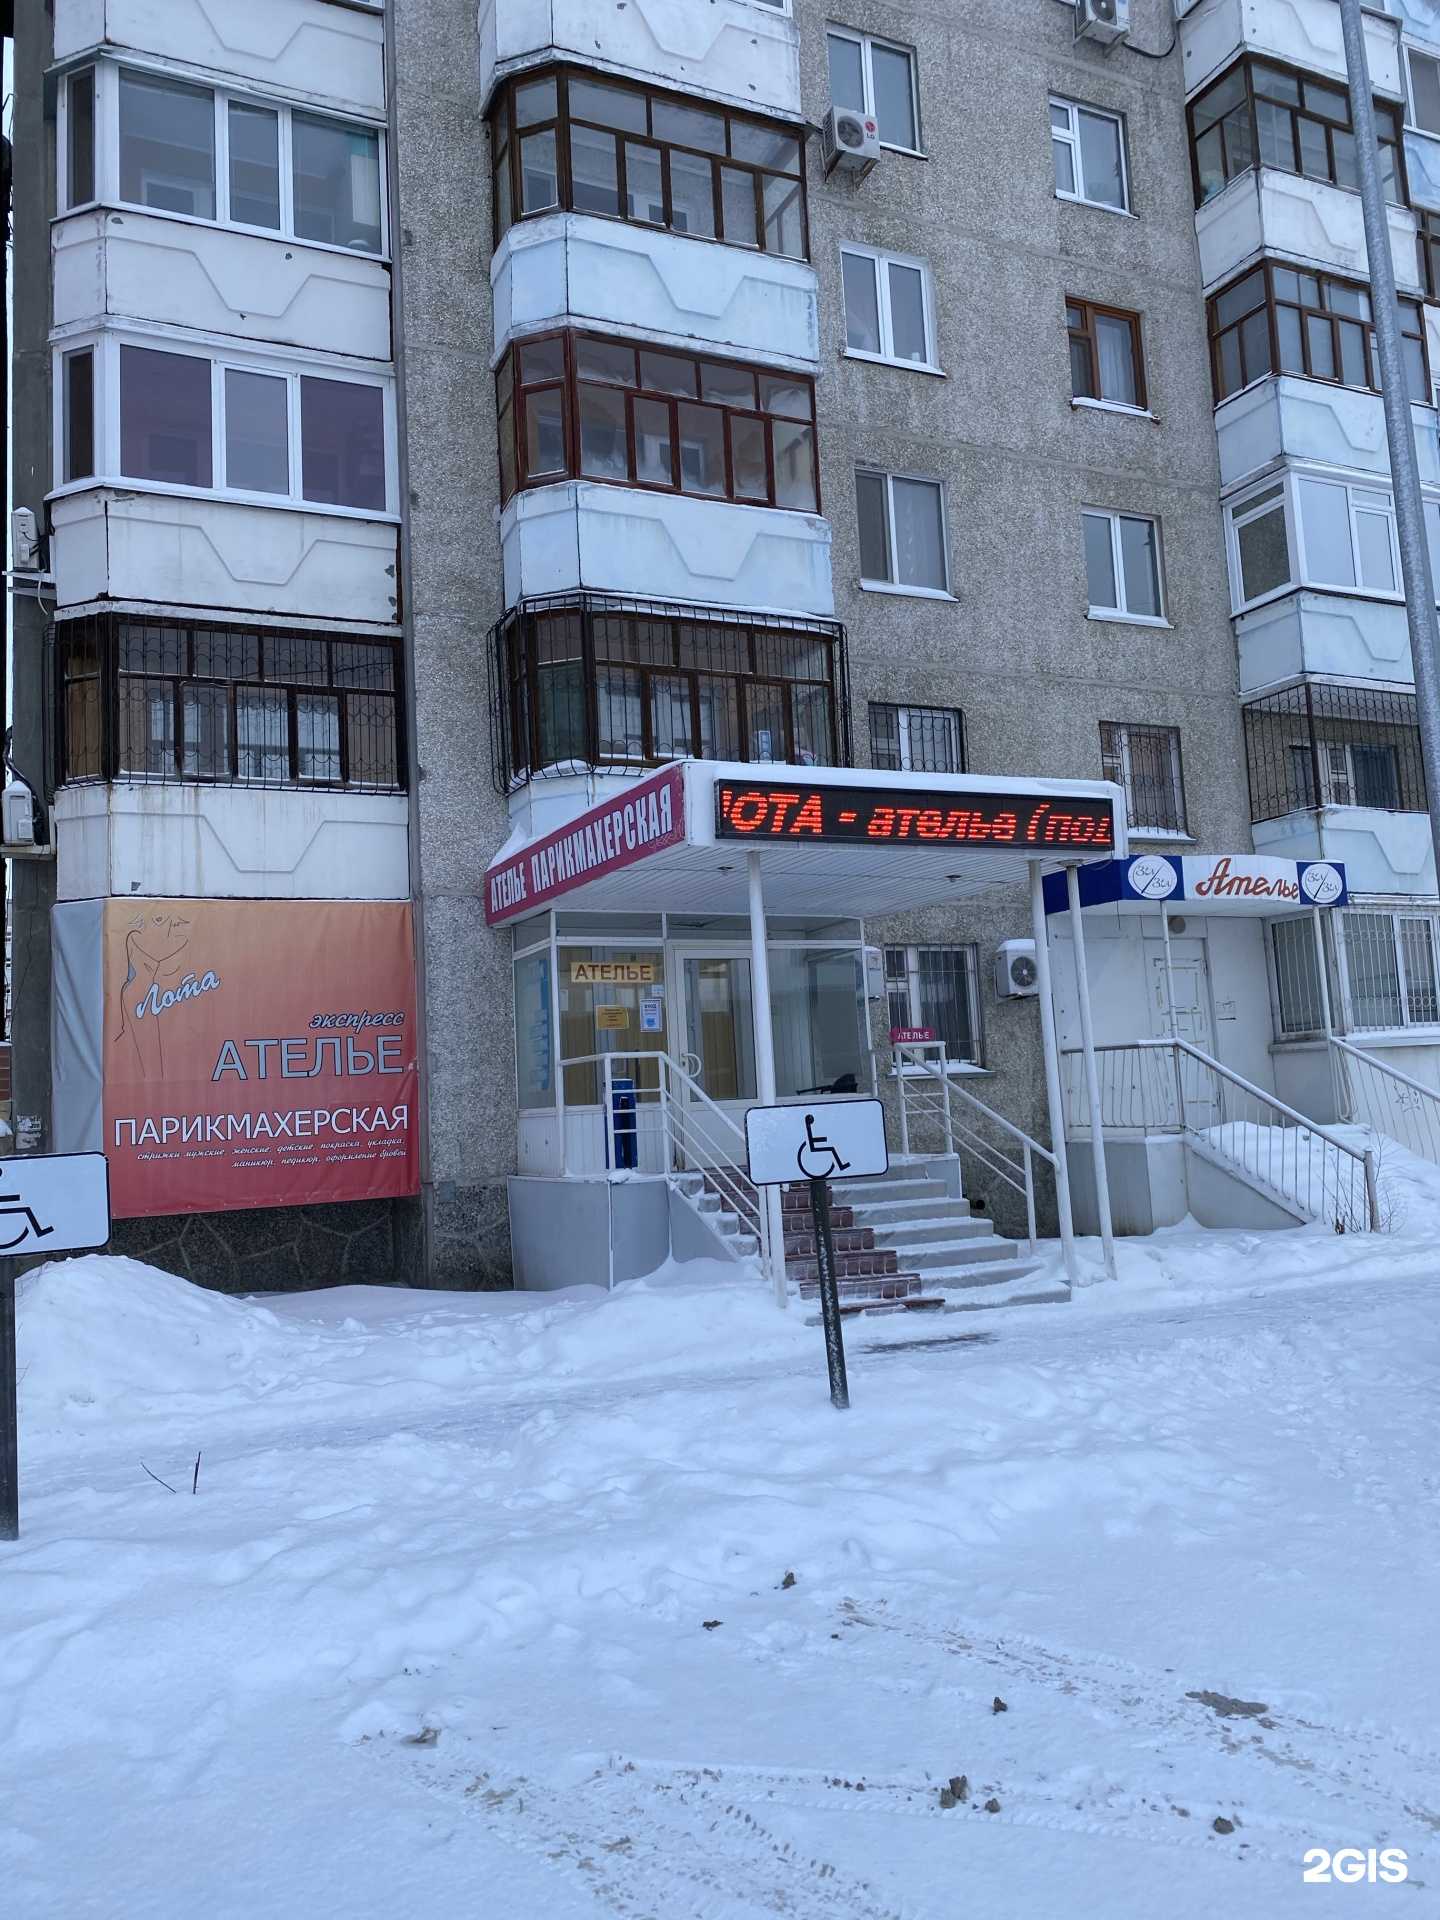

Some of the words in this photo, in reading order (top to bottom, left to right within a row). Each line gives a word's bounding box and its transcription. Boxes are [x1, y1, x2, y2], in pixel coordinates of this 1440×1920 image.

[866, 808, 1017, 840] ателье
[491, 862, 527, 913] АТЕЛЬЕ
[530, 784, 673, 894] ПАРИКМАХЕРСКАЯ
[1195, 857, 1299, 900] Ателье
[135, 969, 221, 1019] Лота
[574, 964, 653, 981] АТЕЛЬЕ
[309, 1009, 405, 1033] экспресс
[897, 1031, 930, 1040] АТЕЛЬЕ
[211, 1034, 404, 1082] АТЕЛЬЕ
[114, 1104, 410, 1147] ПАРИКМАХЕРСКАЯ
